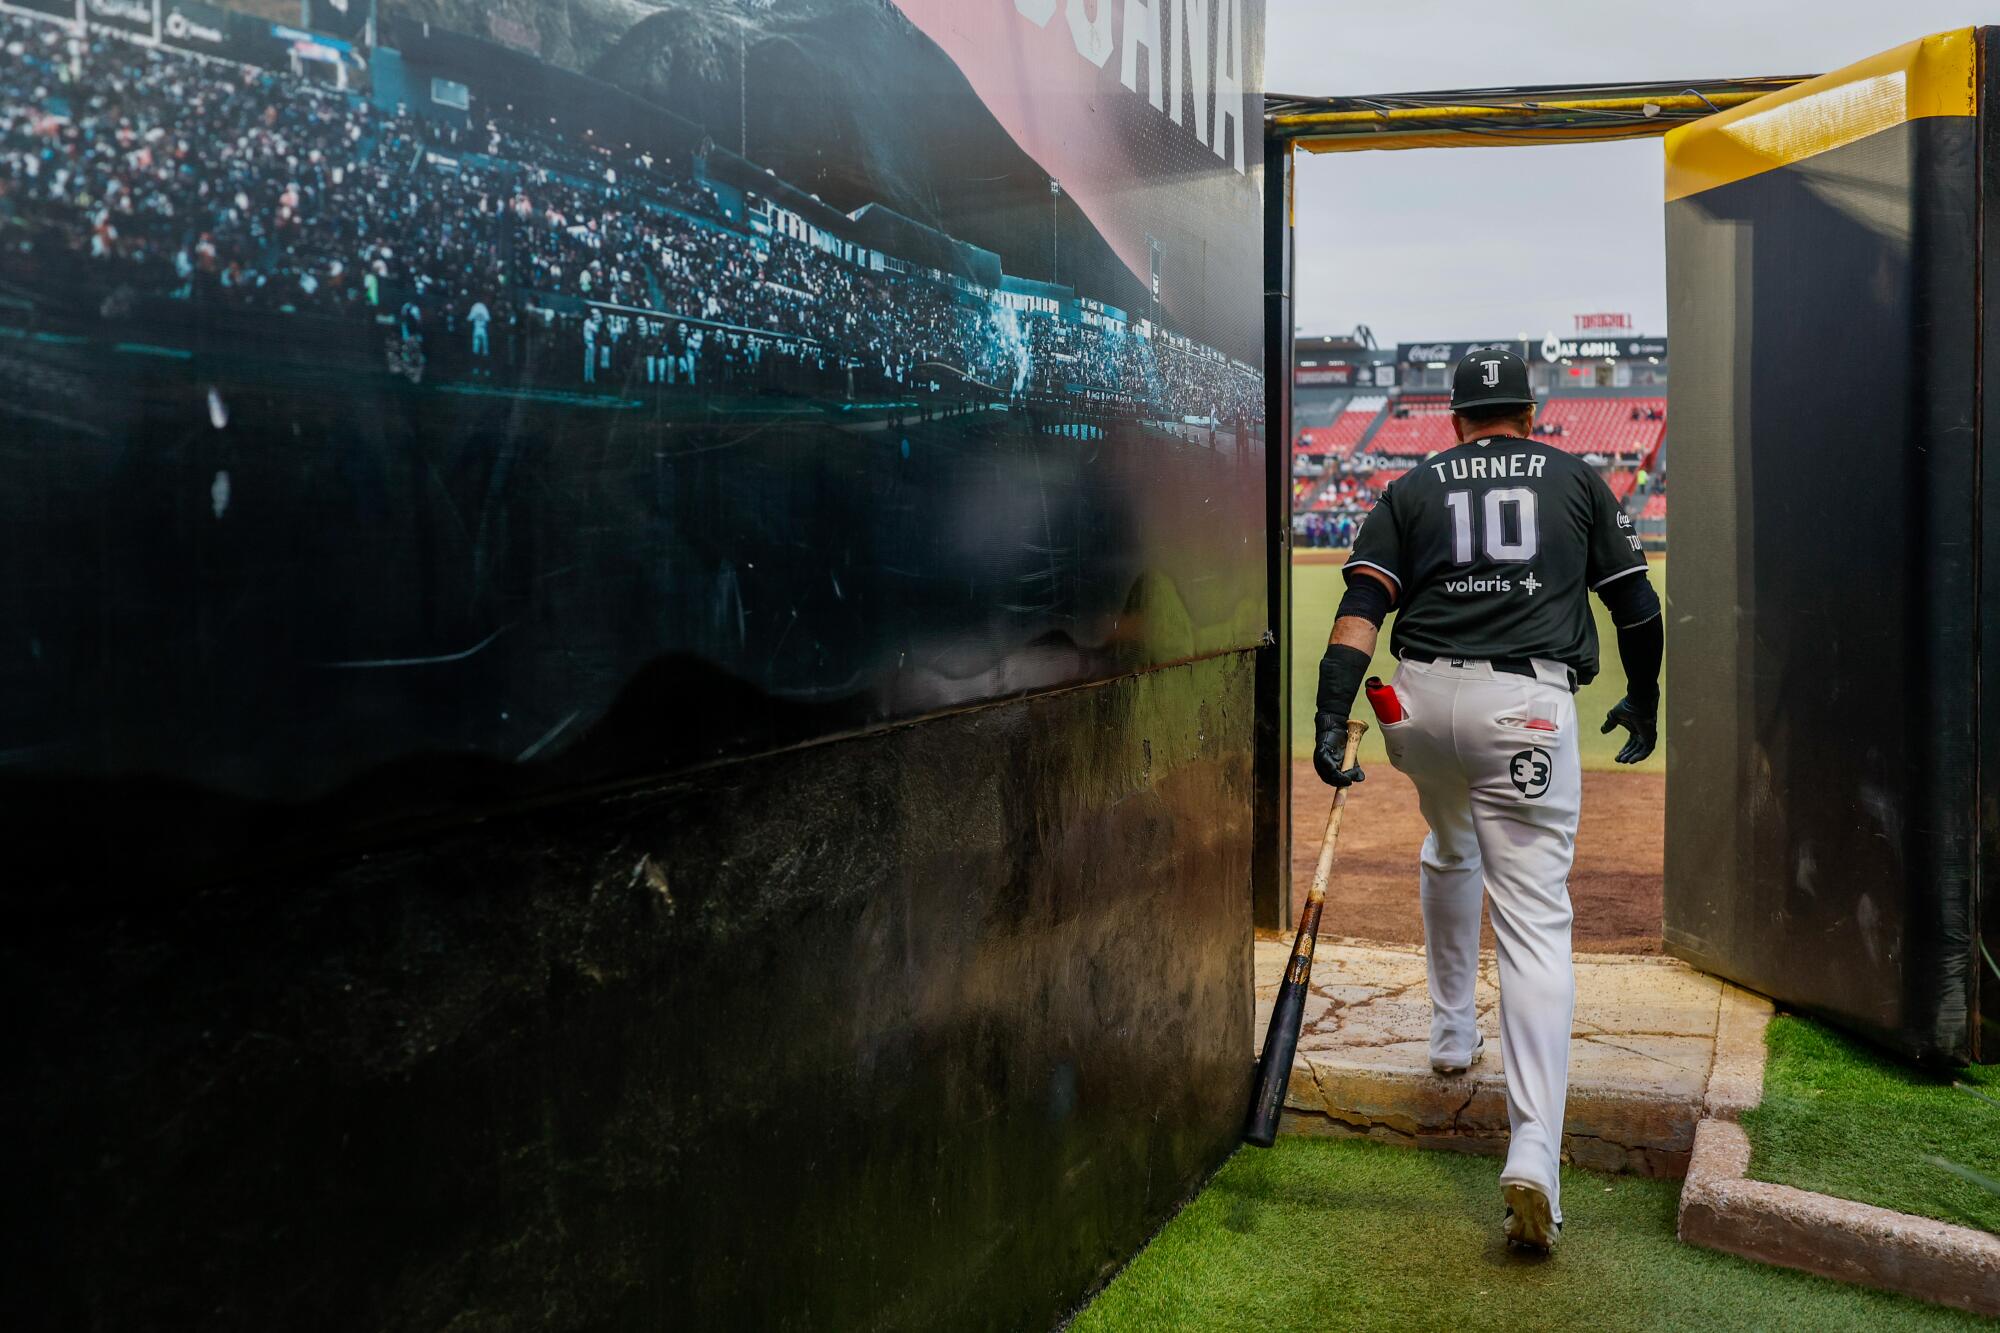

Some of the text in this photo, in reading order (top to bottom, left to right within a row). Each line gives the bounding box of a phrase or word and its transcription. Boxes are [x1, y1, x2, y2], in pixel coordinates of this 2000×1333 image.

[1431, 454, 1547, 483] TURNER
[1444, 485, 1540, 567] 10
[1445, 575, 1511, 592] volaris
